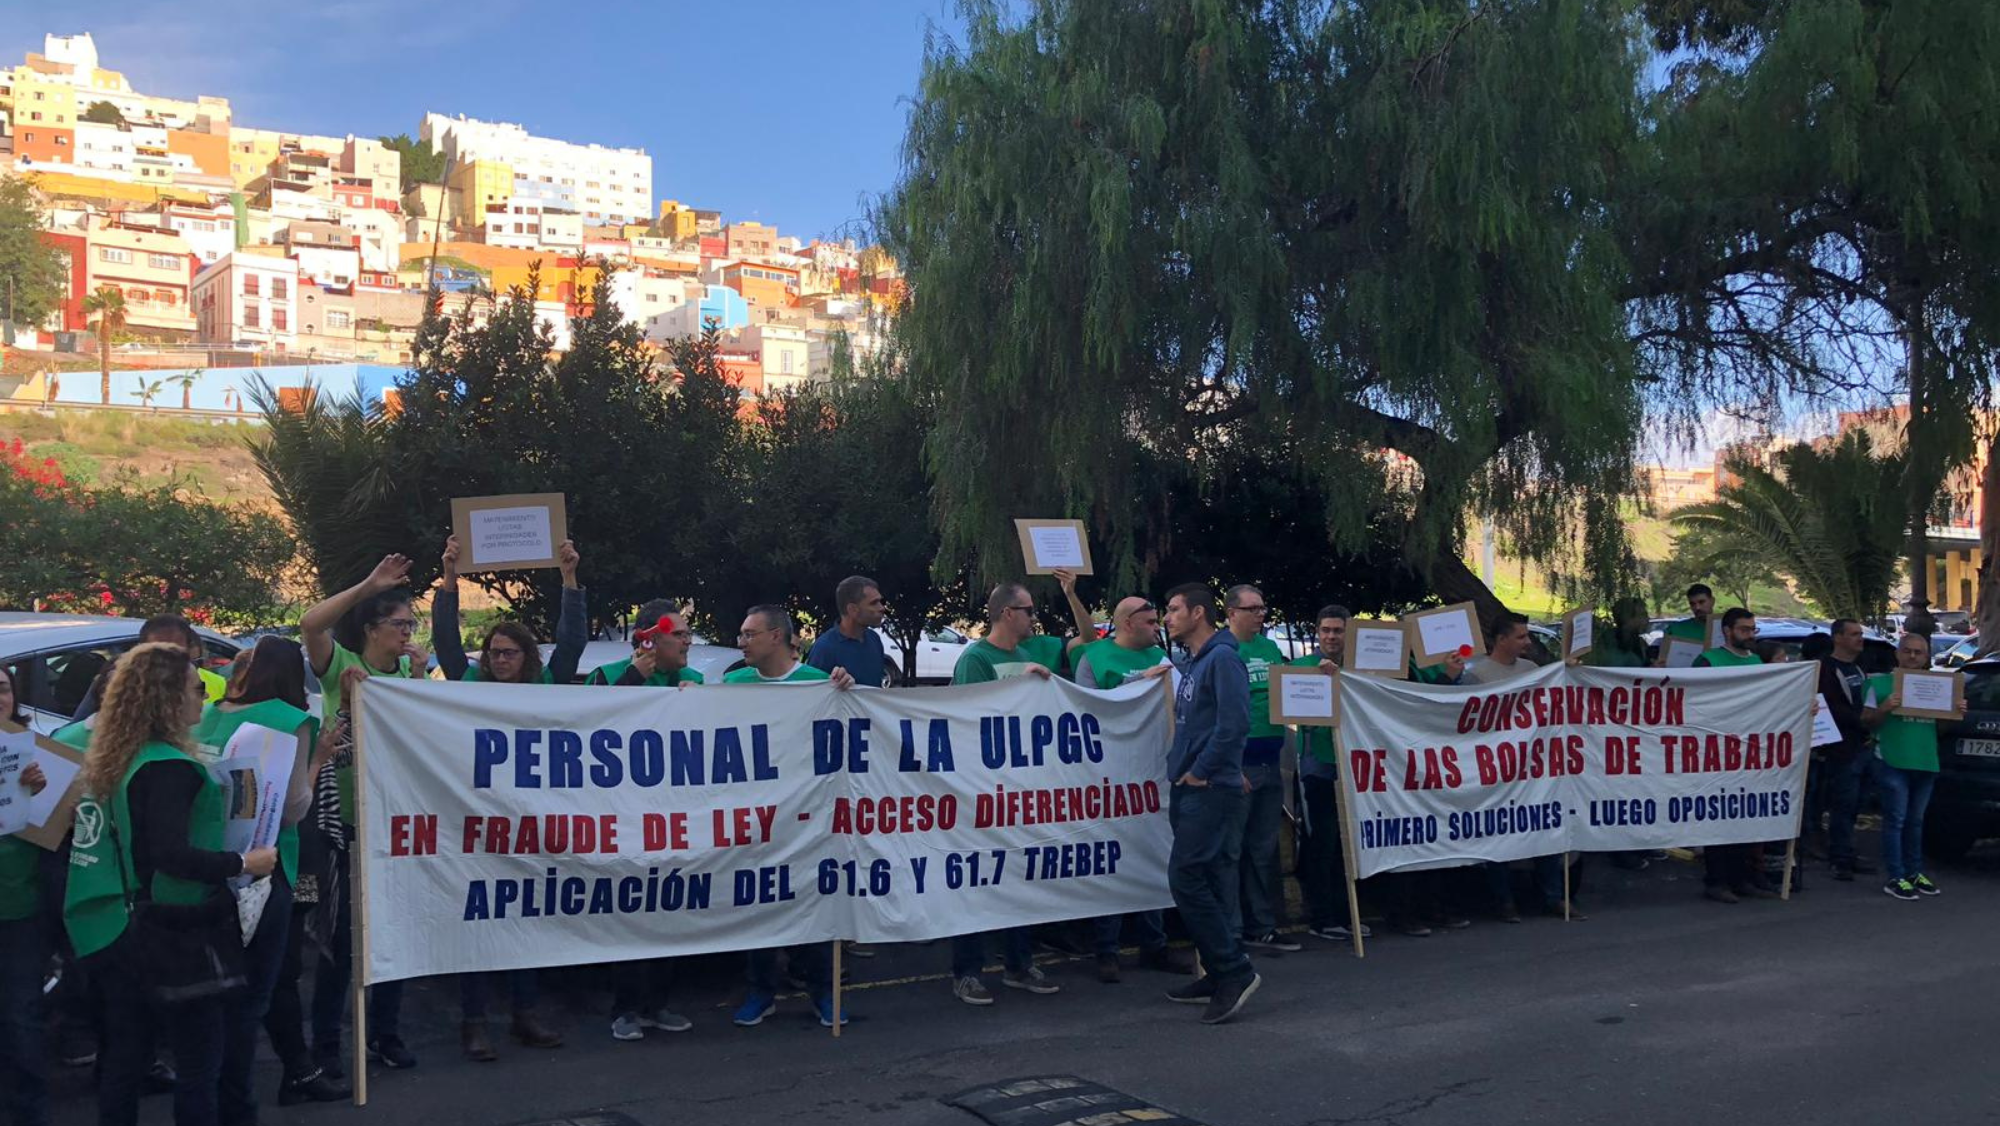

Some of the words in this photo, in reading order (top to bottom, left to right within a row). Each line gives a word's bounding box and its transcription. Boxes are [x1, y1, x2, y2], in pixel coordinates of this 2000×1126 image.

[473, 724, 779, 789] PERSONAL
[812, 717, 871, 775] DE
[898, 718, 956, 773] LA
[979, 712, 1104, 770] ULPGC
[1350, 749, 1387, 793] DE
[1403, 745, 1462, 791] LAS
[1475, 735, 1585, 786] BOLSAS
[1605, 735, 1642, 775] DE
[1660, 731, 1793, 774] TRABAJO
[390, 814, 438, 857] EN
[462, 815, 619, 854] FRAUDE
[643, 812, 689, 852] DE
[713, 805, 777, 848] LEY
[831, 795, 957, 835] ACCESO
[1590, 798, 1656, 827] LUEGO
[733, 863, 795, 907] DEL
[817, 857, 891, 897] 61.6
[910, 856, 928, 894] Y
[945, 849, 1006, 890] 61.7
[1024, 840, 1122, 881] TREBEP
